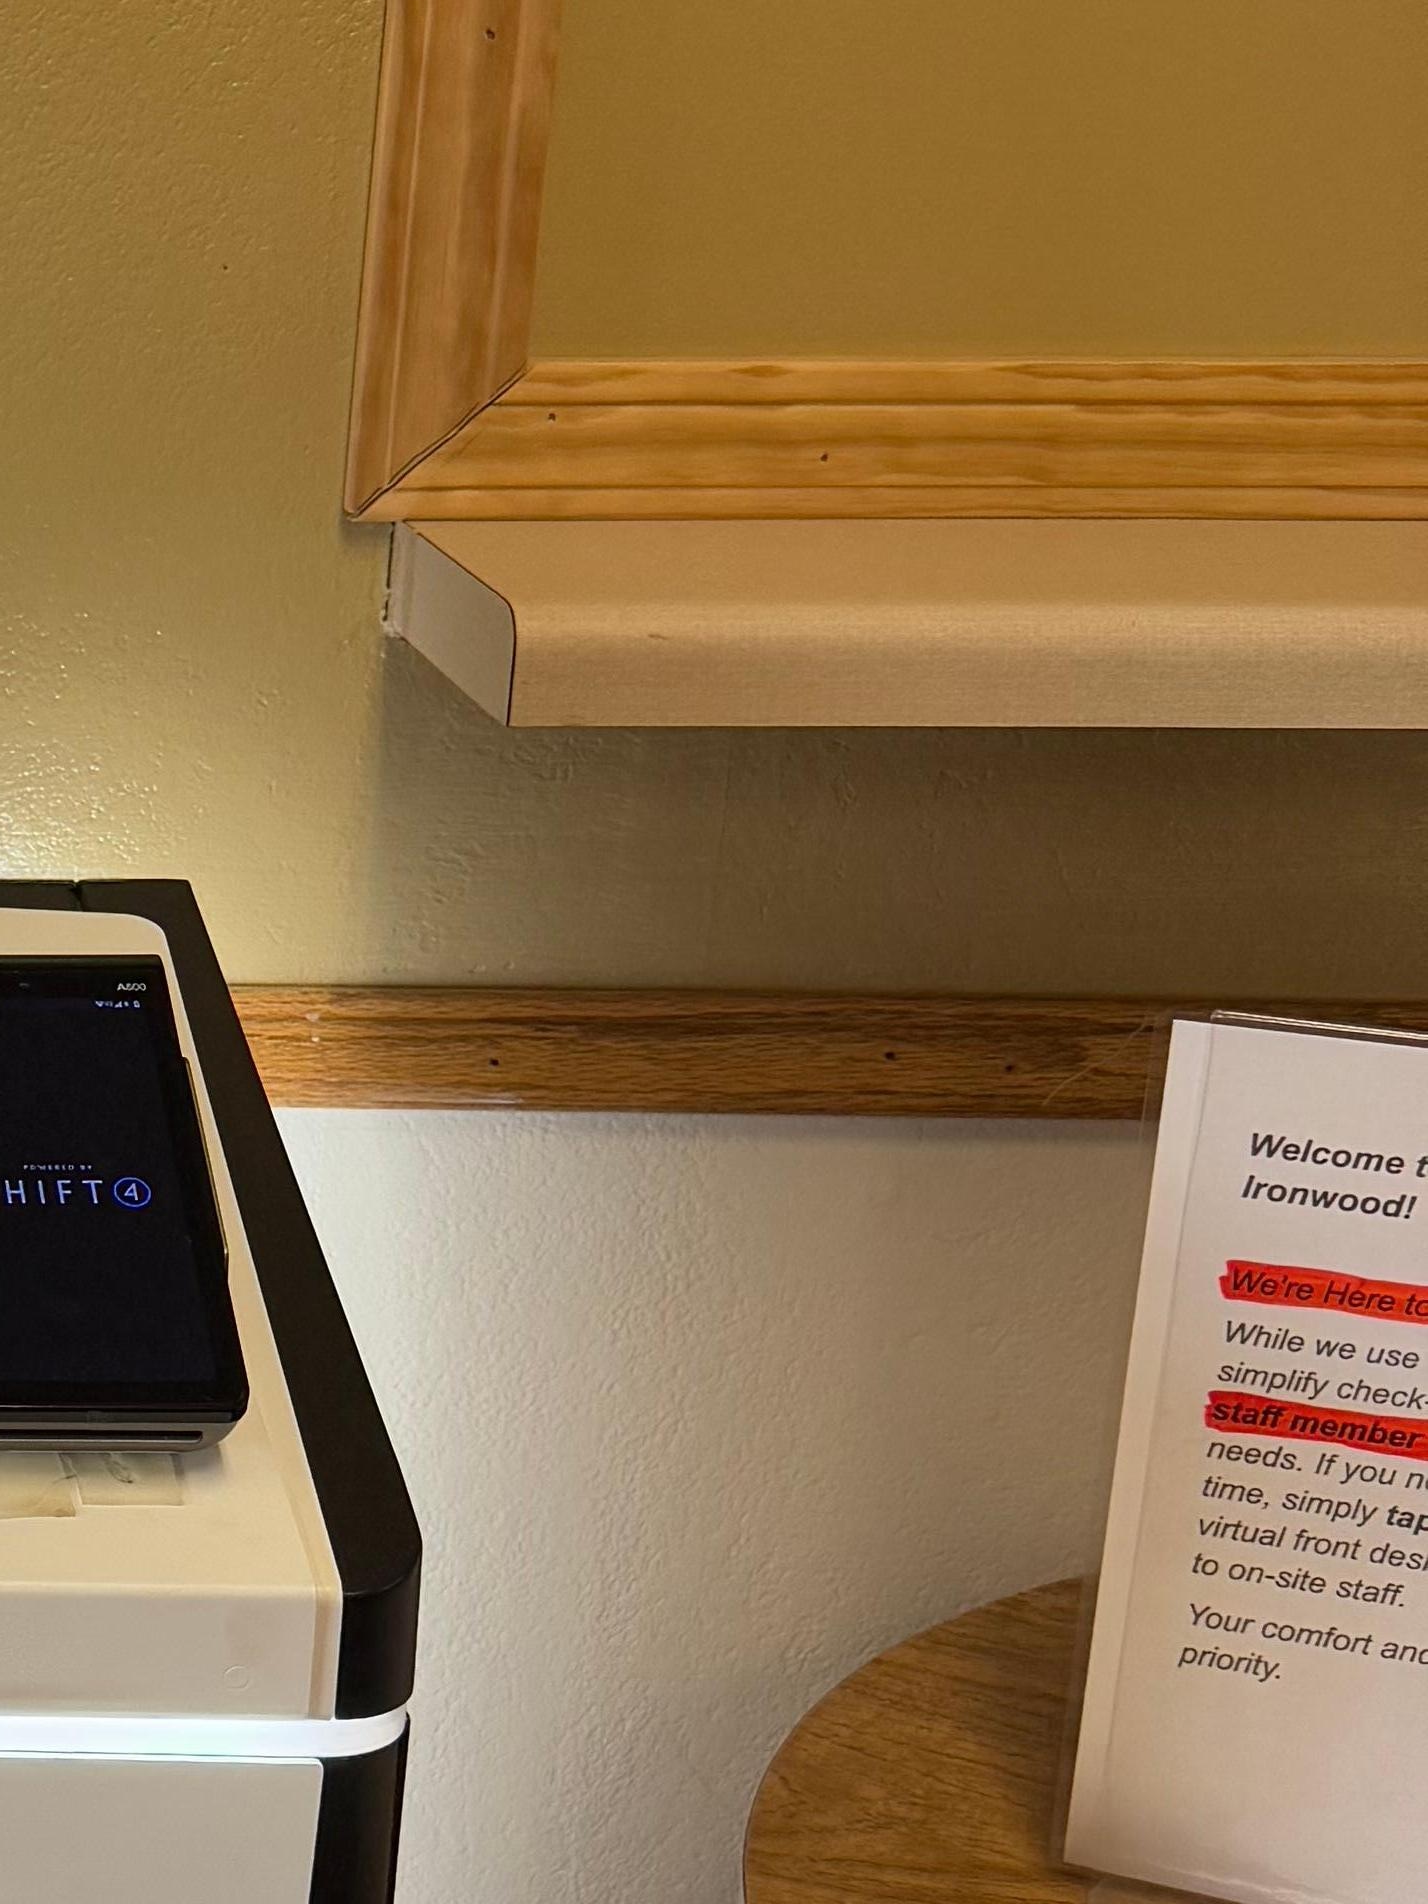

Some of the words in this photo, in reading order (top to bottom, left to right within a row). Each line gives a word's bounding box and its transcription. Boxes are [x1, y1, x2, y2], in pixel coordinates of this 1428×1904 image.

[1249, 1132, 1405, 1175] Welcome
[1241, 1175, 1418, 1220] Ironwood!
[1231, 1265, 1315, 1303] We're
[1323, 1280, 1396, 1312] Here
[1224, 1320, 1306, 1353] While
[1316, 1338, 1357, 1360] we
[1366, 1346, 1420, 1369] use
[1217, 1362, 1329, 1400] simplify
[1211, 1401, 1284, 1430] staff
[1289, 1412, 1426, 1449] member
[1205, 1440, 1302, 1472] needs.
[1313, 1452, 1340, 1476] If
[1339, 1462, 1397, 1485] you
[1404, 1472, 1428, 1490] n
[1201, 1476, 1269, 1510] time,
[1281, 1490, 1379, 1528] simply
[1198, 1516, 1287, 1548] virtual
[1292, 1528, 1363, 1561] front
[1191, 1552, 1219, 1576] to
[1228, 1563, 1328, 1595] on-site
[1335, 1576, 1406, 1607] staff.
[1189, 1603, 1255, 1635] Your
[1261, 1619, 1374, 1656] comfort
[1177, 1645, 1282, 1683] priority.
